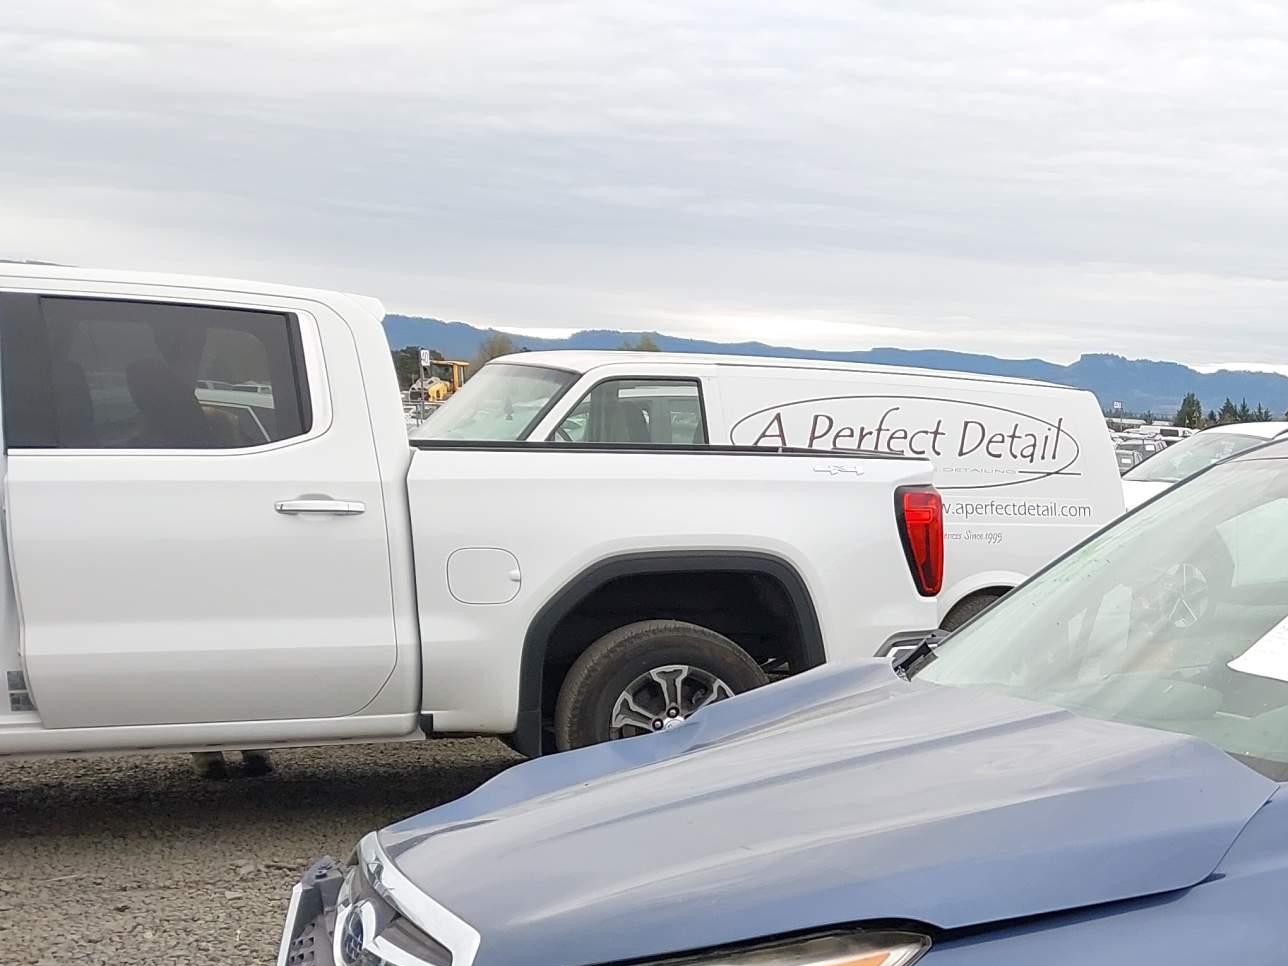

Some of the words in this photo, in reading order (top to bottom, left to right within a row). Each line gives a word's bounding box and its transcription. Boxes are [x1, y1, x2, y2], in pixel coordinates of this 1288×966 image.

[752, 411, 787, 447] A
[807, 406, 946, 457] Perfect
[957, 417, 1064, 465] Detail
[942, 467, 1017, 475] DETAILING
[963, 529, 984, 541] Since
